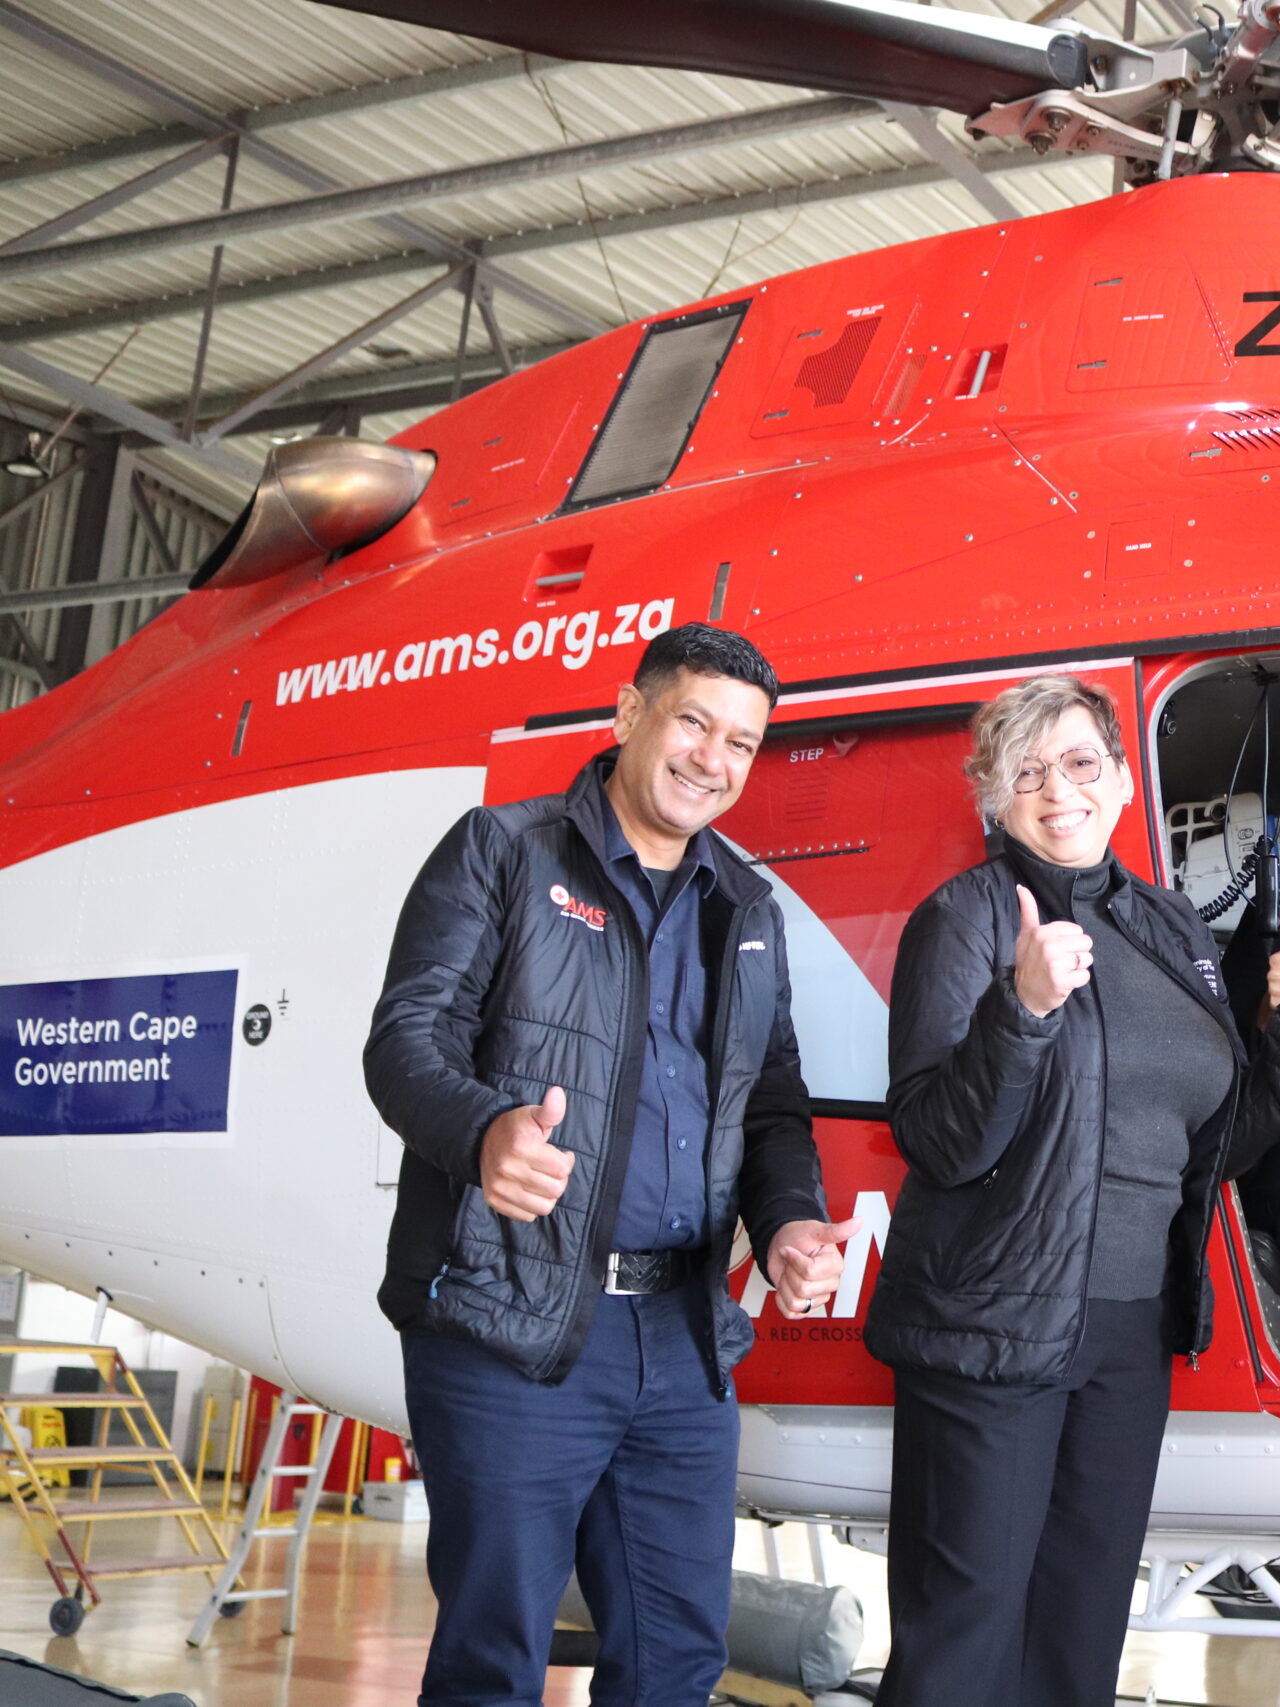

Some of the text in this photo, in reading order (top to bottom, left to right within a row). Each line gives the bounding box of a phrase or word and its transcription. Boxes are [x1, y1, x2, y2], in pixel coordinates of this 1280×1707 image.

[276, 597, 675, 706] www.ams.org.za
[789, 747, 824, 763] STEP
[563, 896, 607, 927] AMS
[17, 1011, 197, 1047] Western Cape
[15, 1053, 171, 1086] Government
[770, 1327, 802, 1342] RED
[808, 1327, 862, 1342] CROSS
